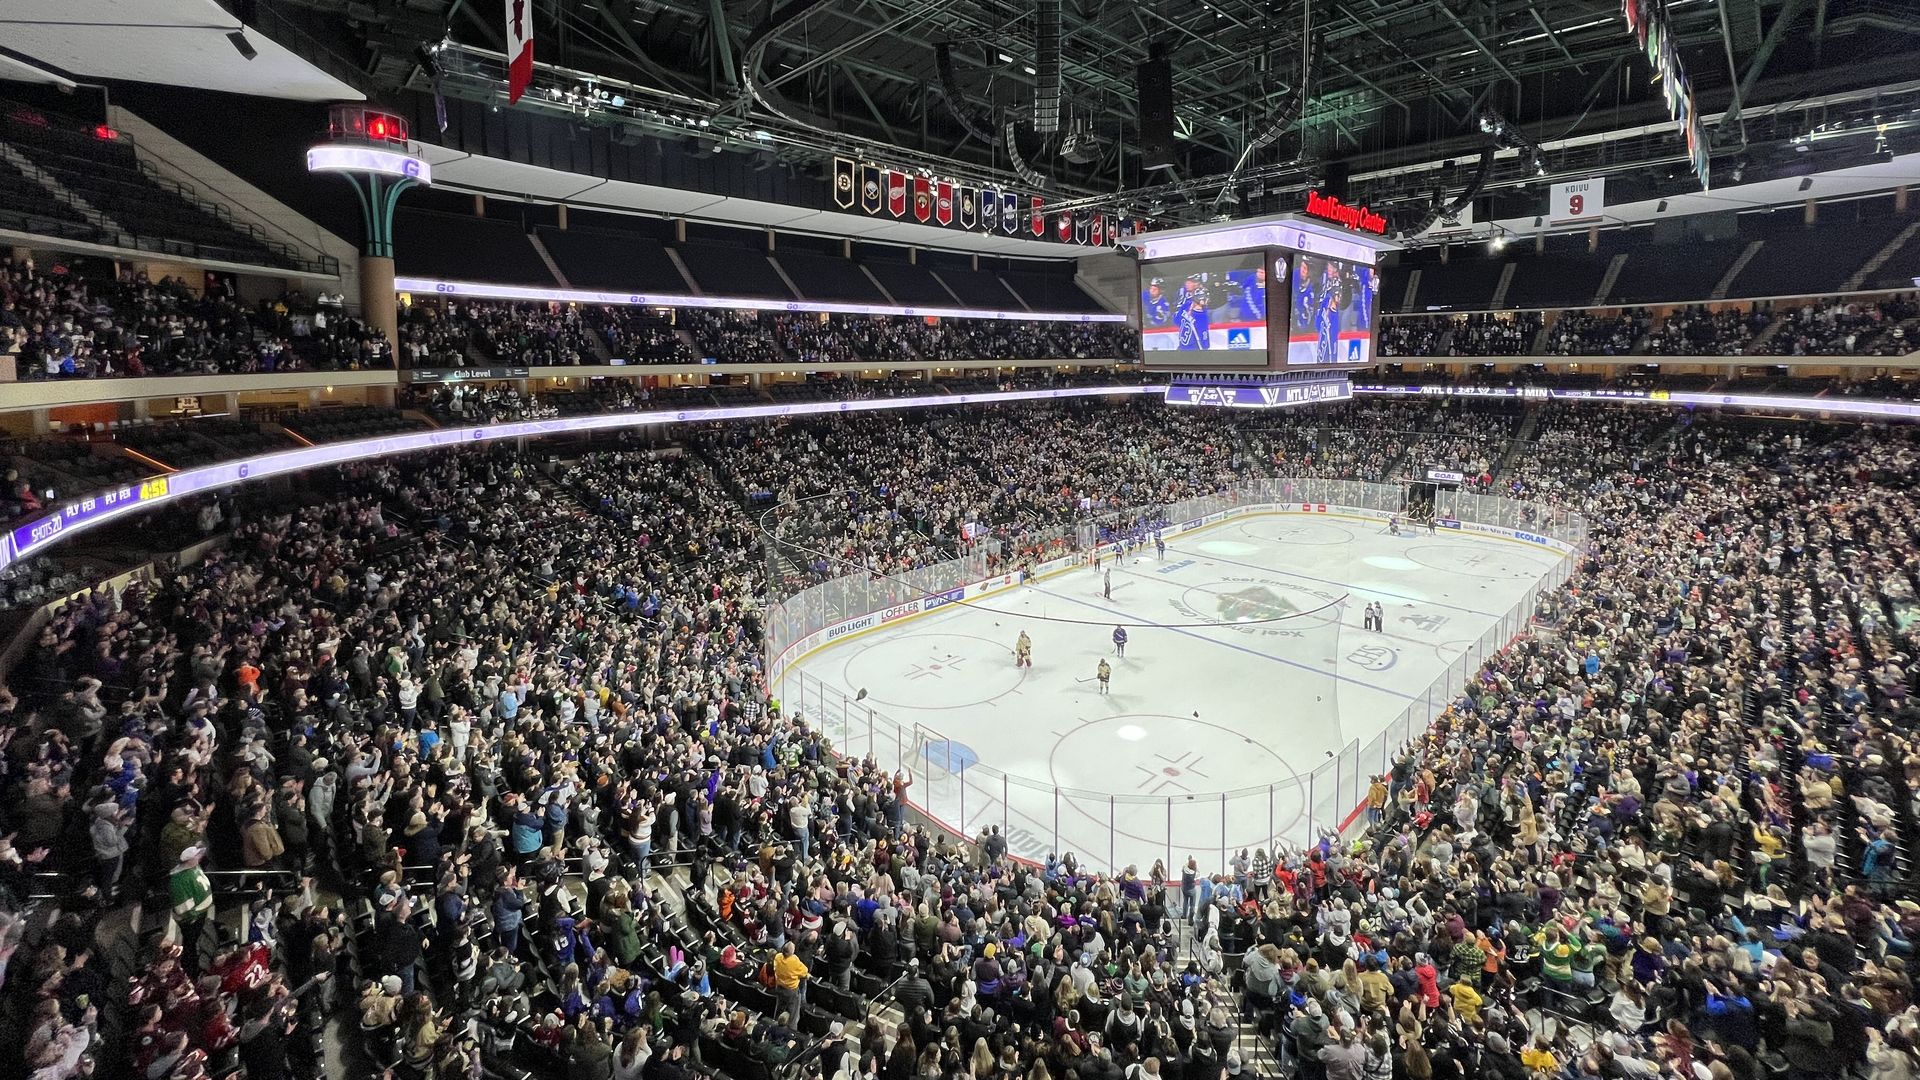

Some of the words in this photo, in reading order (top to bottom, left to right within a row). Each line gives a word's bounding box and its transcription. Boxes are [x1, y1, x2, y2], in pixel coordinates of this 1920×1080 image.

[1565, 184, 1589, 193] KOIVU
[1306, 191, 1331, 218] Xcel
[1330, 198, 1360, 230] Energy
[1360, 207, 1387, 233] Center
[1570, 195, 1584, 215] 9
[454, 370, 470, 378] Club
[471, 369, 491, 378] Level
[1286, 389, 1303, 401] MTL
[1320, 387, 1326, 398] 2
[1326, 386, 1339, 397] MIN
[1424, 387, 1444, 395] MTL
[1525, 387, 1547, 397] MIN
[239, 464, 249, 478] G
[1434, 472, 1456, 480] GOAL
[31, 521, 52, 543] SHOTS
[51, 515, 63, 531] 20
[66, 503, 80, 517] PLY
[82, 499, 96, 513] PEN
[105, 492, 117, 505] PLY
[119, 488, 131, 501] PEN
[1514, 531, 1547, 545] ECOLAB
[881, 602, 919, 620] LOFFLER
[828, 624, 847, 638] BUD
[847, 617, 873, 631] LIGHT
[244, 963, 266, 988] 22
